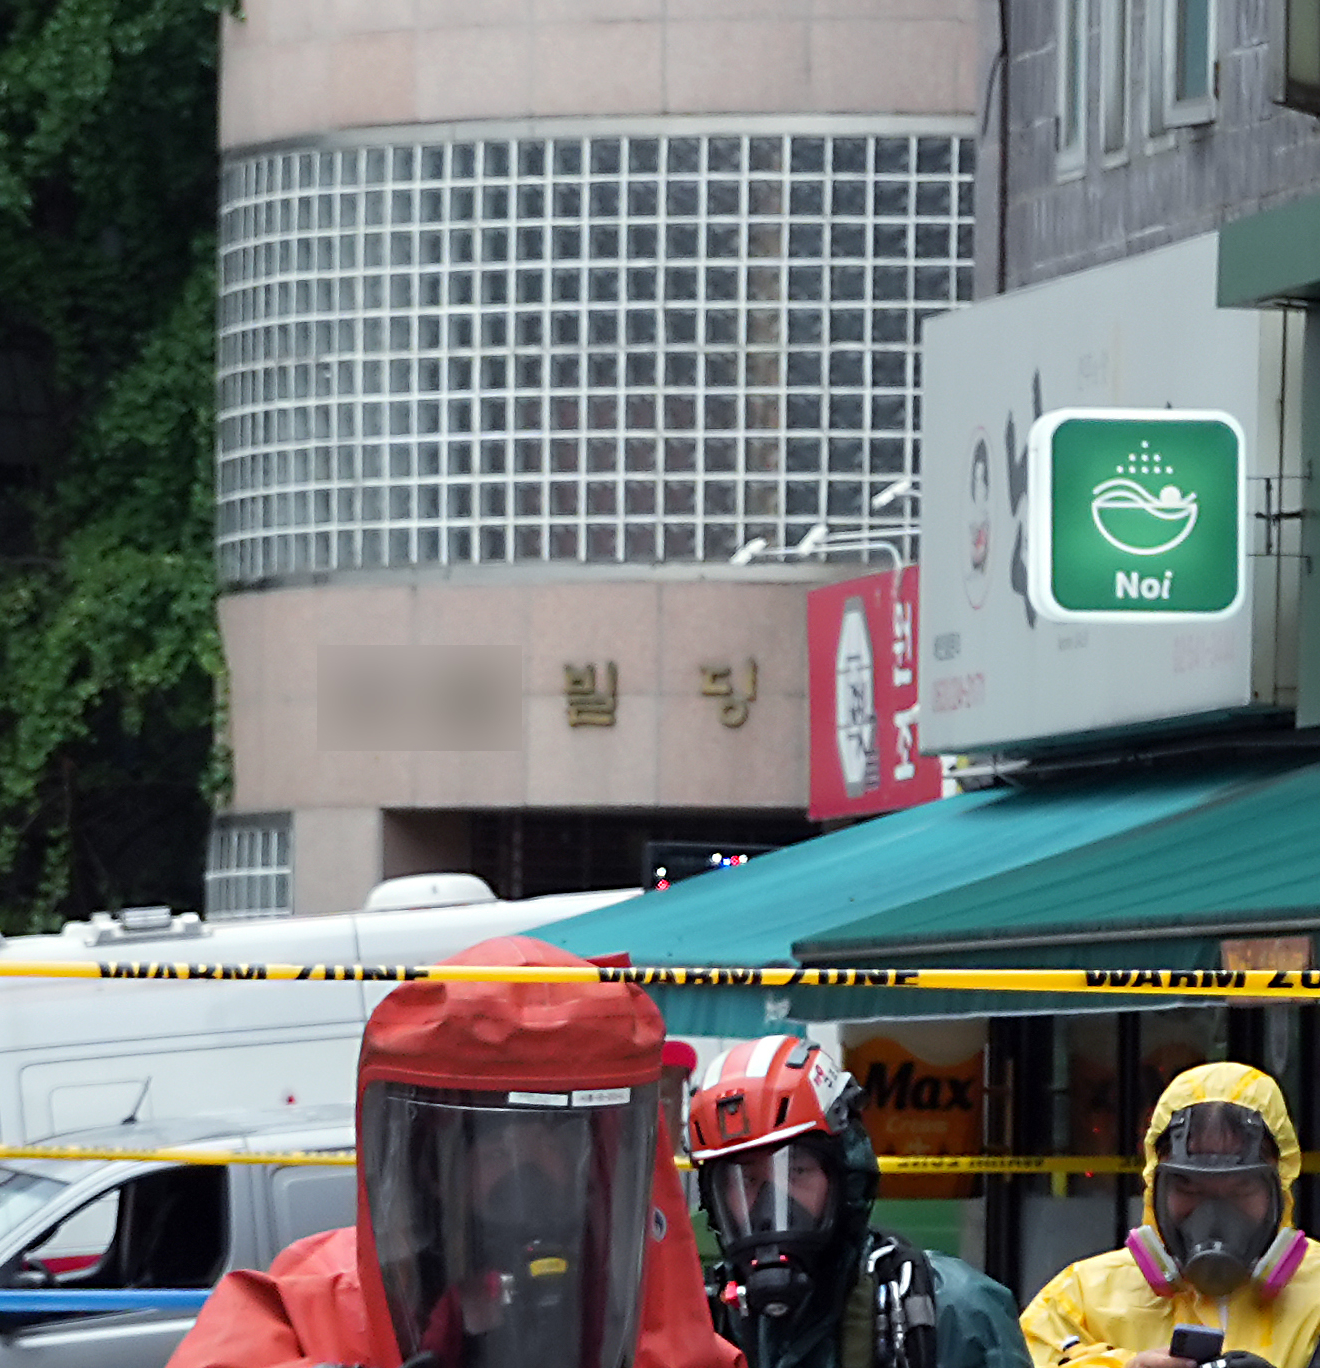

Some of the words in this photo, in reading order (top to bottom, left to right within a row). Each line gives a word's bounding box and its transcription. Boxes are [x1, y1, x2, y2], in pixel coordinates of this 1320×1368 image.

[1115, 570, 1174, 600] Noi
[562, 657, 759, 730] 빌딩
[863, 1060, 978, 1112] Max
